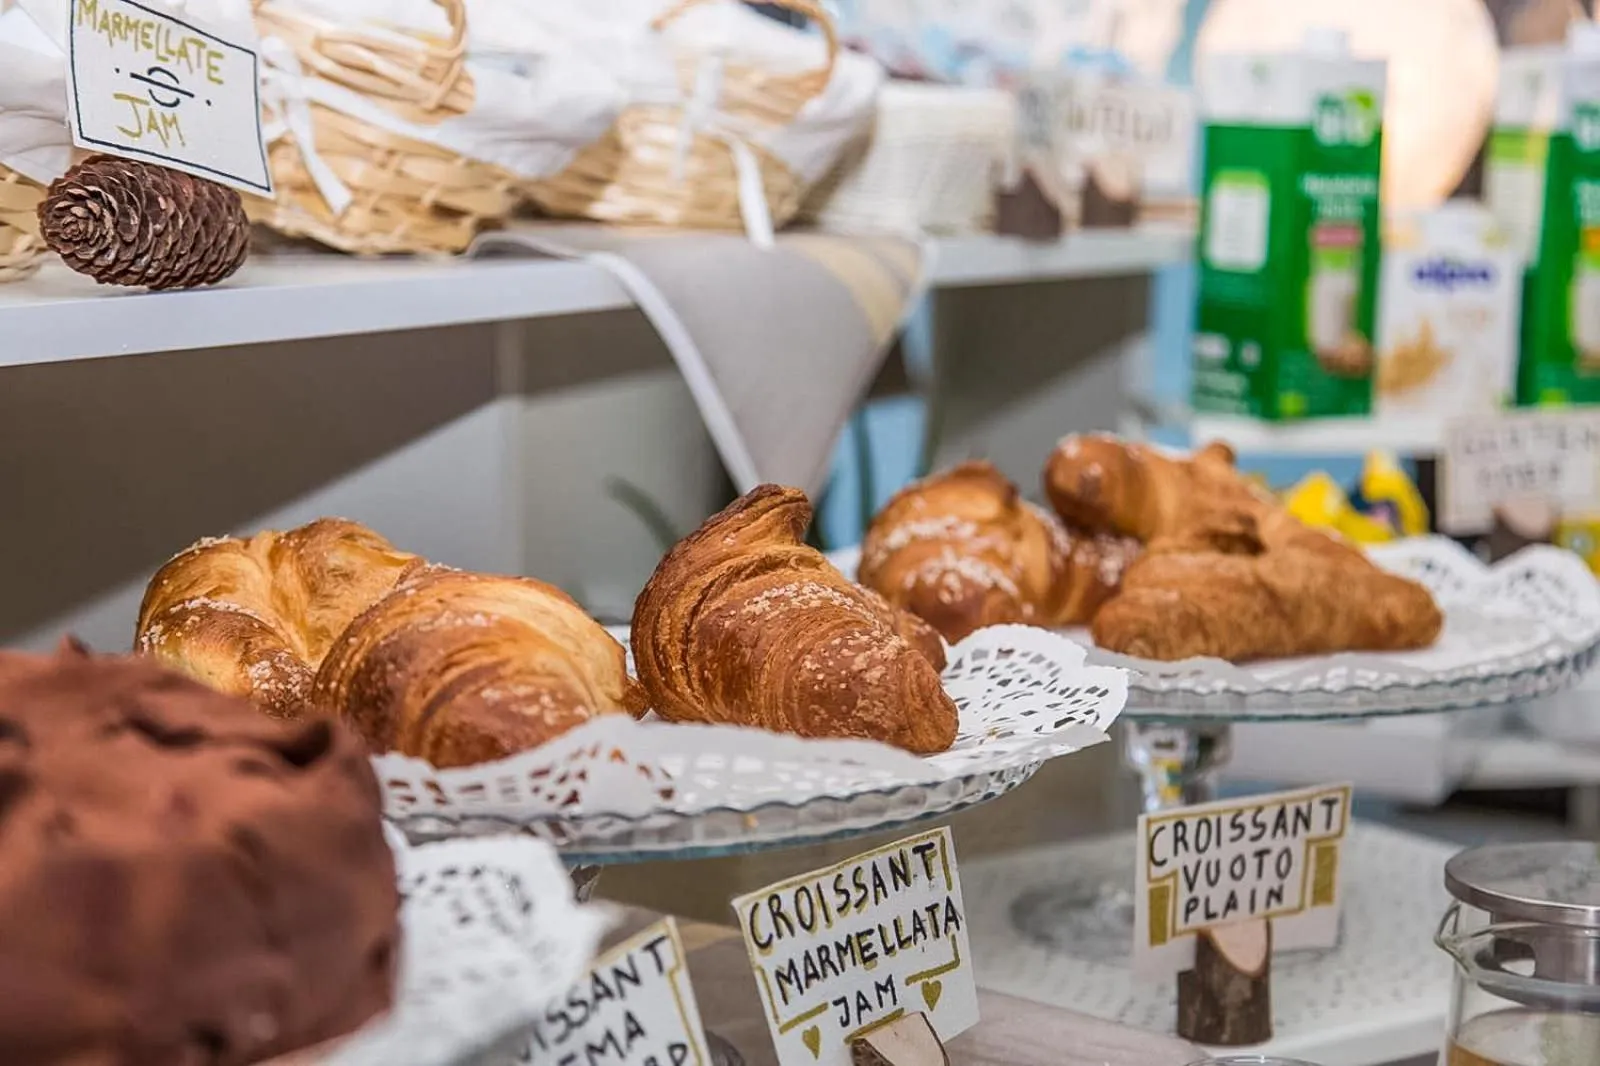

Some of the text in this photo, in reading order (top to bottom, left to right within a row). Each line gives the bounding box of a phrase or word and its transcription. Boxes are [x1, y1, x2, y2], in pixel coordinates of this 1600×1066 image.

[77, 0, 224, 85] MARMELLATE
[112, 92, 186, 149] JAM
[1150, 797, 1339, 867] CROISSANT
[749, 841, 937, 952] CROISSANT
[1183, 846, 1293, 893] VUOTO
[1183, 884, 1284, 924] PLAIN
[774, 895, 961, 1006] MARMELLATA
[832, 973, 898, 1028] JAM
